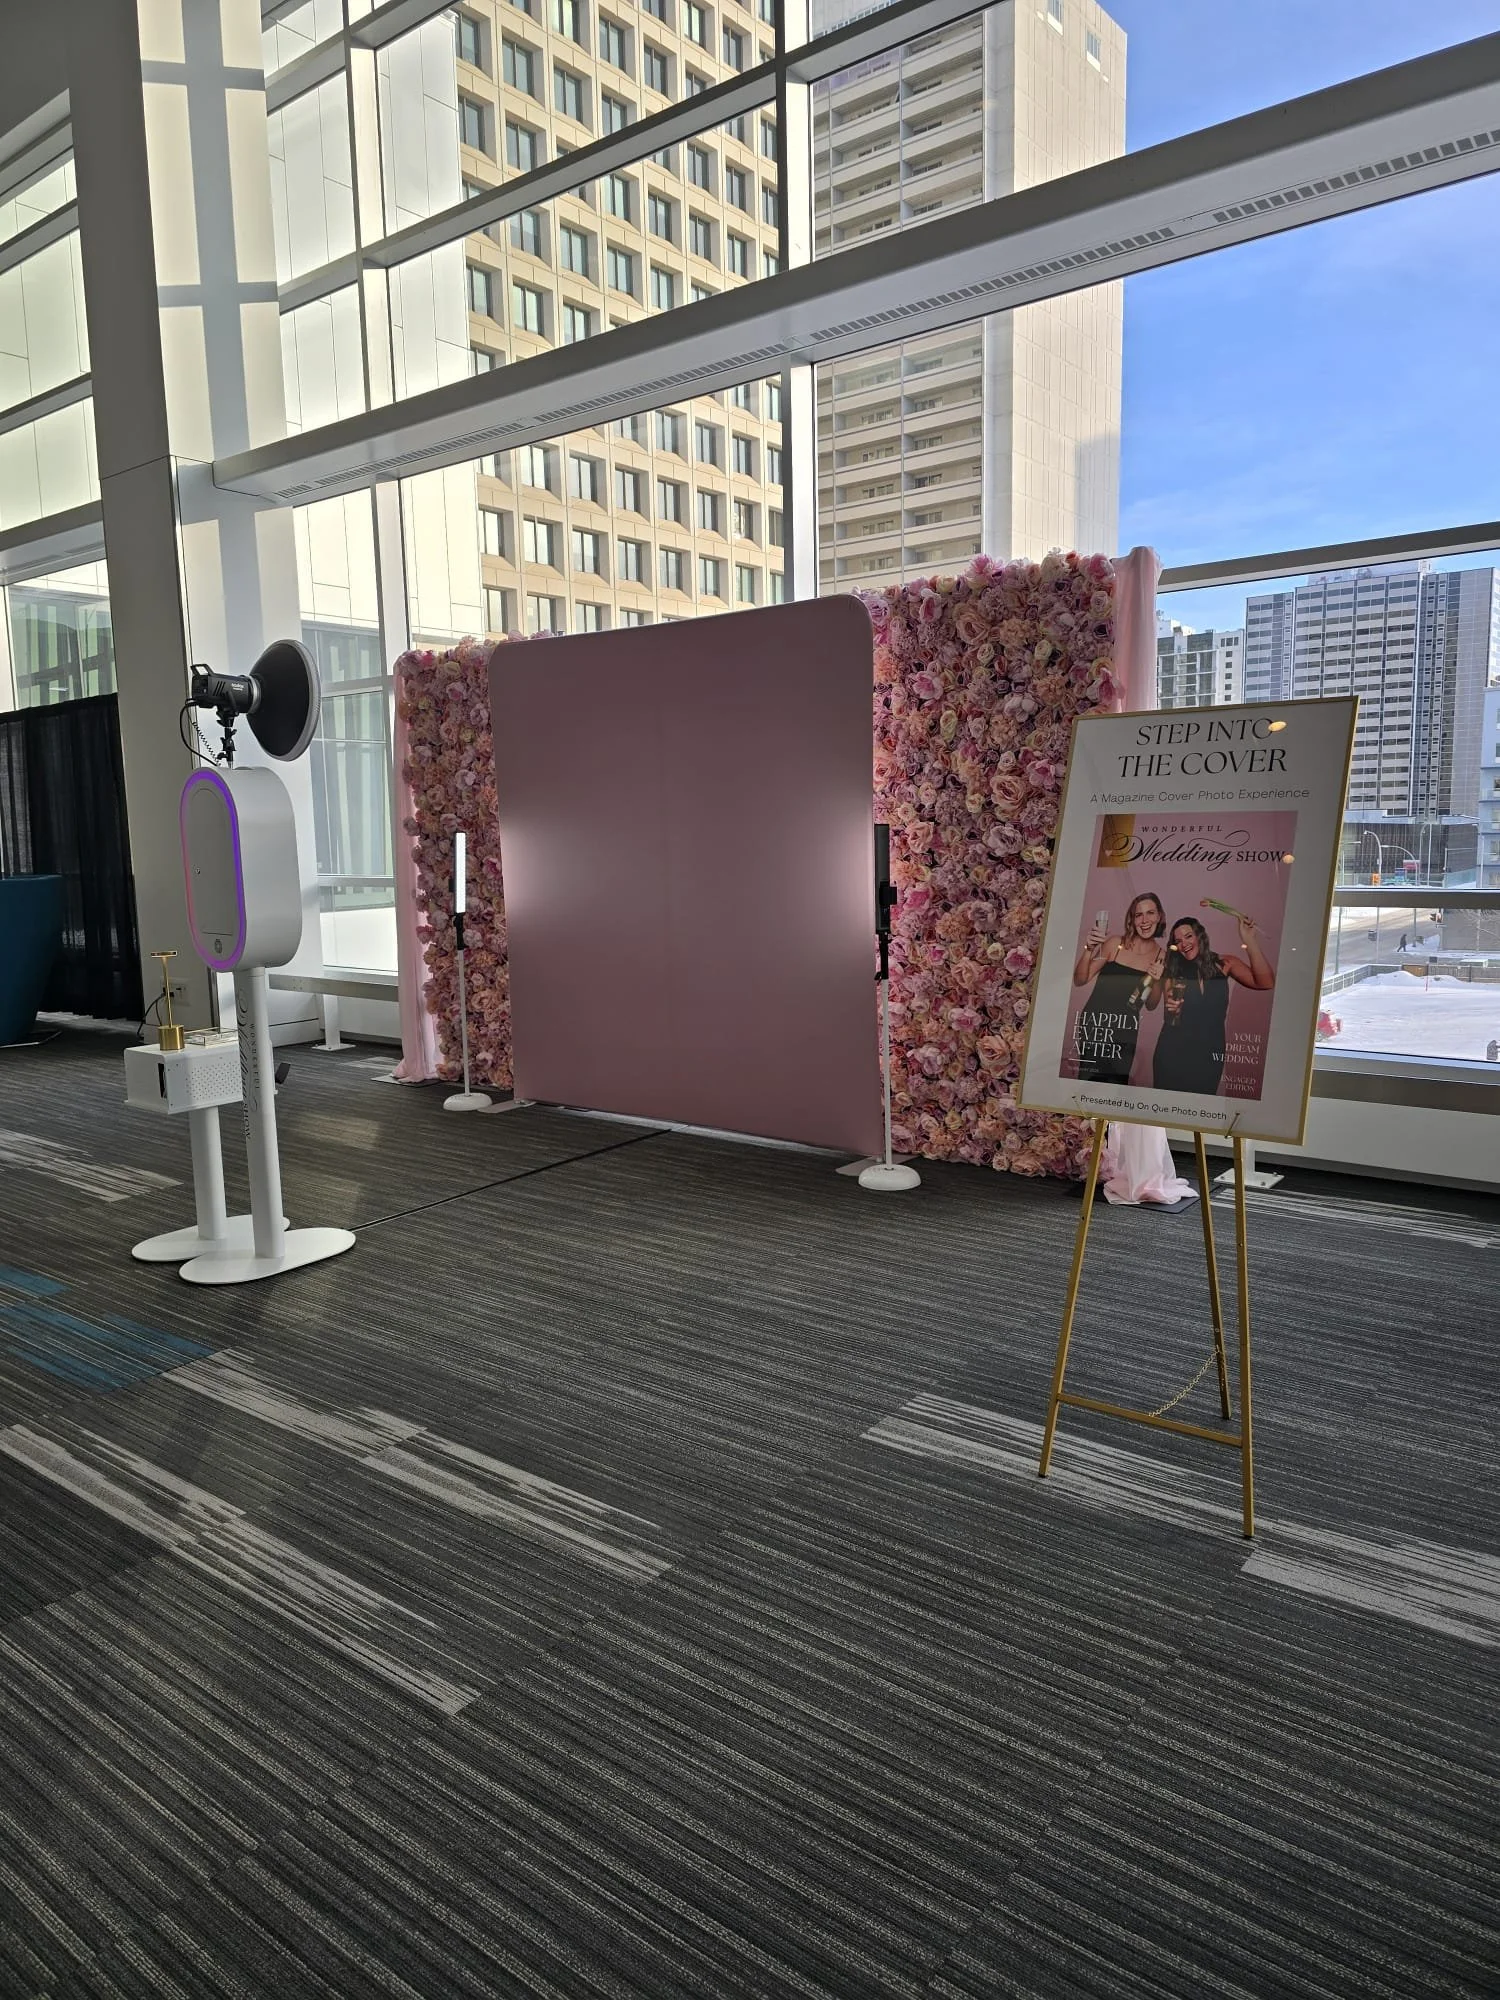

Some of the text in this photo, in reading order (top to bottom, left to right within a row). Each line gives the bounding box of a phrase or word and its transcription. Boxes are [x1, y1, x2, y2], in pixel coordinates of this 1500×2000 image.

[1136, 717, 1275, 746] STEP INTO
[1118, 748, 1287, 778] THE COVER
[1090, 788, 1310, 805] A Magazine Cover Photo Experience
[1141, 825, 1223, 834] WONDERFUL
[1102, 829, 1285, 872] Wedding SHOW
[1074, 1010, 1143, 1030] HAPPILY
[1072, 1025, 1114, 1043] EVER
[1234, 1032, 1261, 1043] YOUR
[1069, 1040, 1122, 1060] AFTER
[1225, 1042, 1260, 1054] DREAM
[1212, 1052, 1259, 1065] WEDDING
[1080, 1095, 1227, 1121] Presented by On Que Photo Booth
